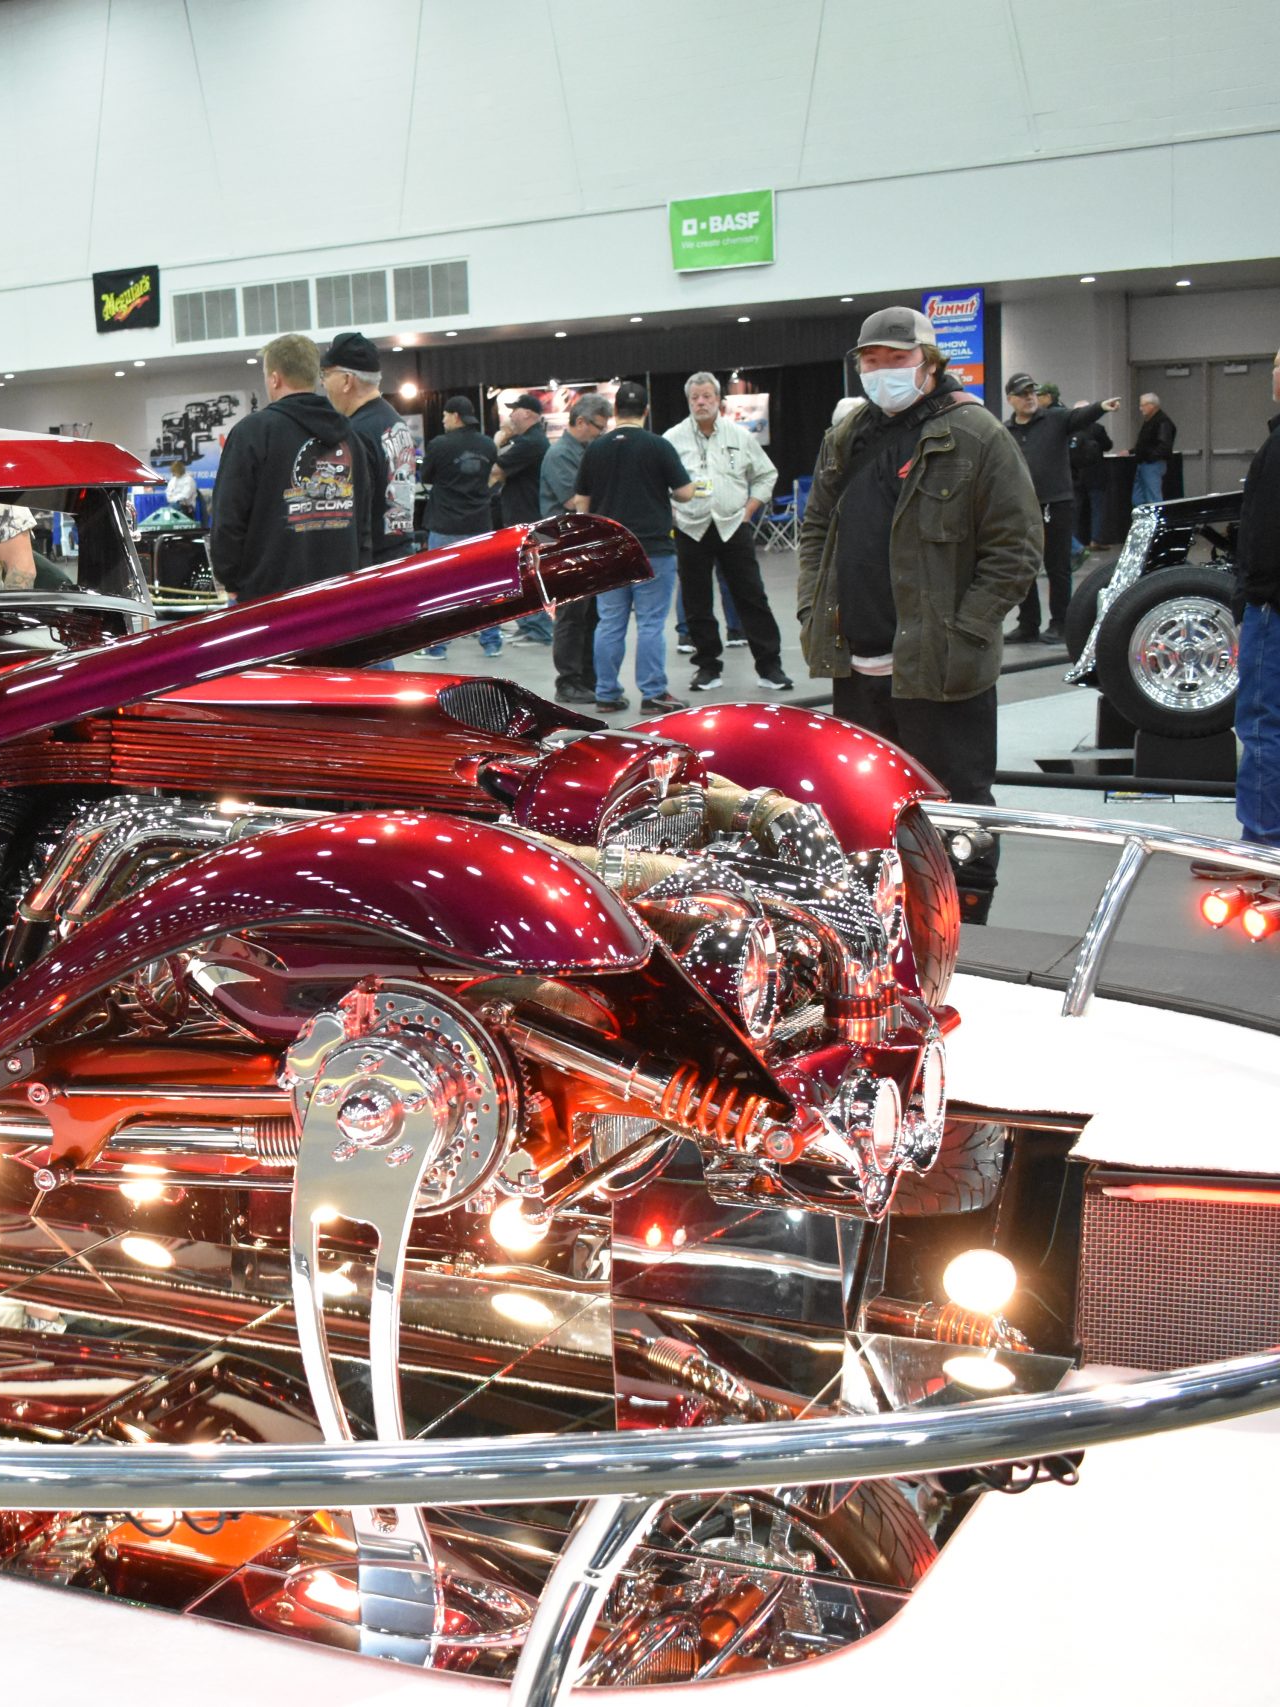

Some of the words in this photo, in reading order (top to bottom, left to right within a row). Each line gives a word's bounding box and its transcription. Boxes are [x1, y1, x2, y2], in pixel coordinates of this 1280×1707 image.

[708, 210, 760, 234] BASF
[928, 298, 977, 319] SUMMIT
[315, 500, 354, 511] COMP
